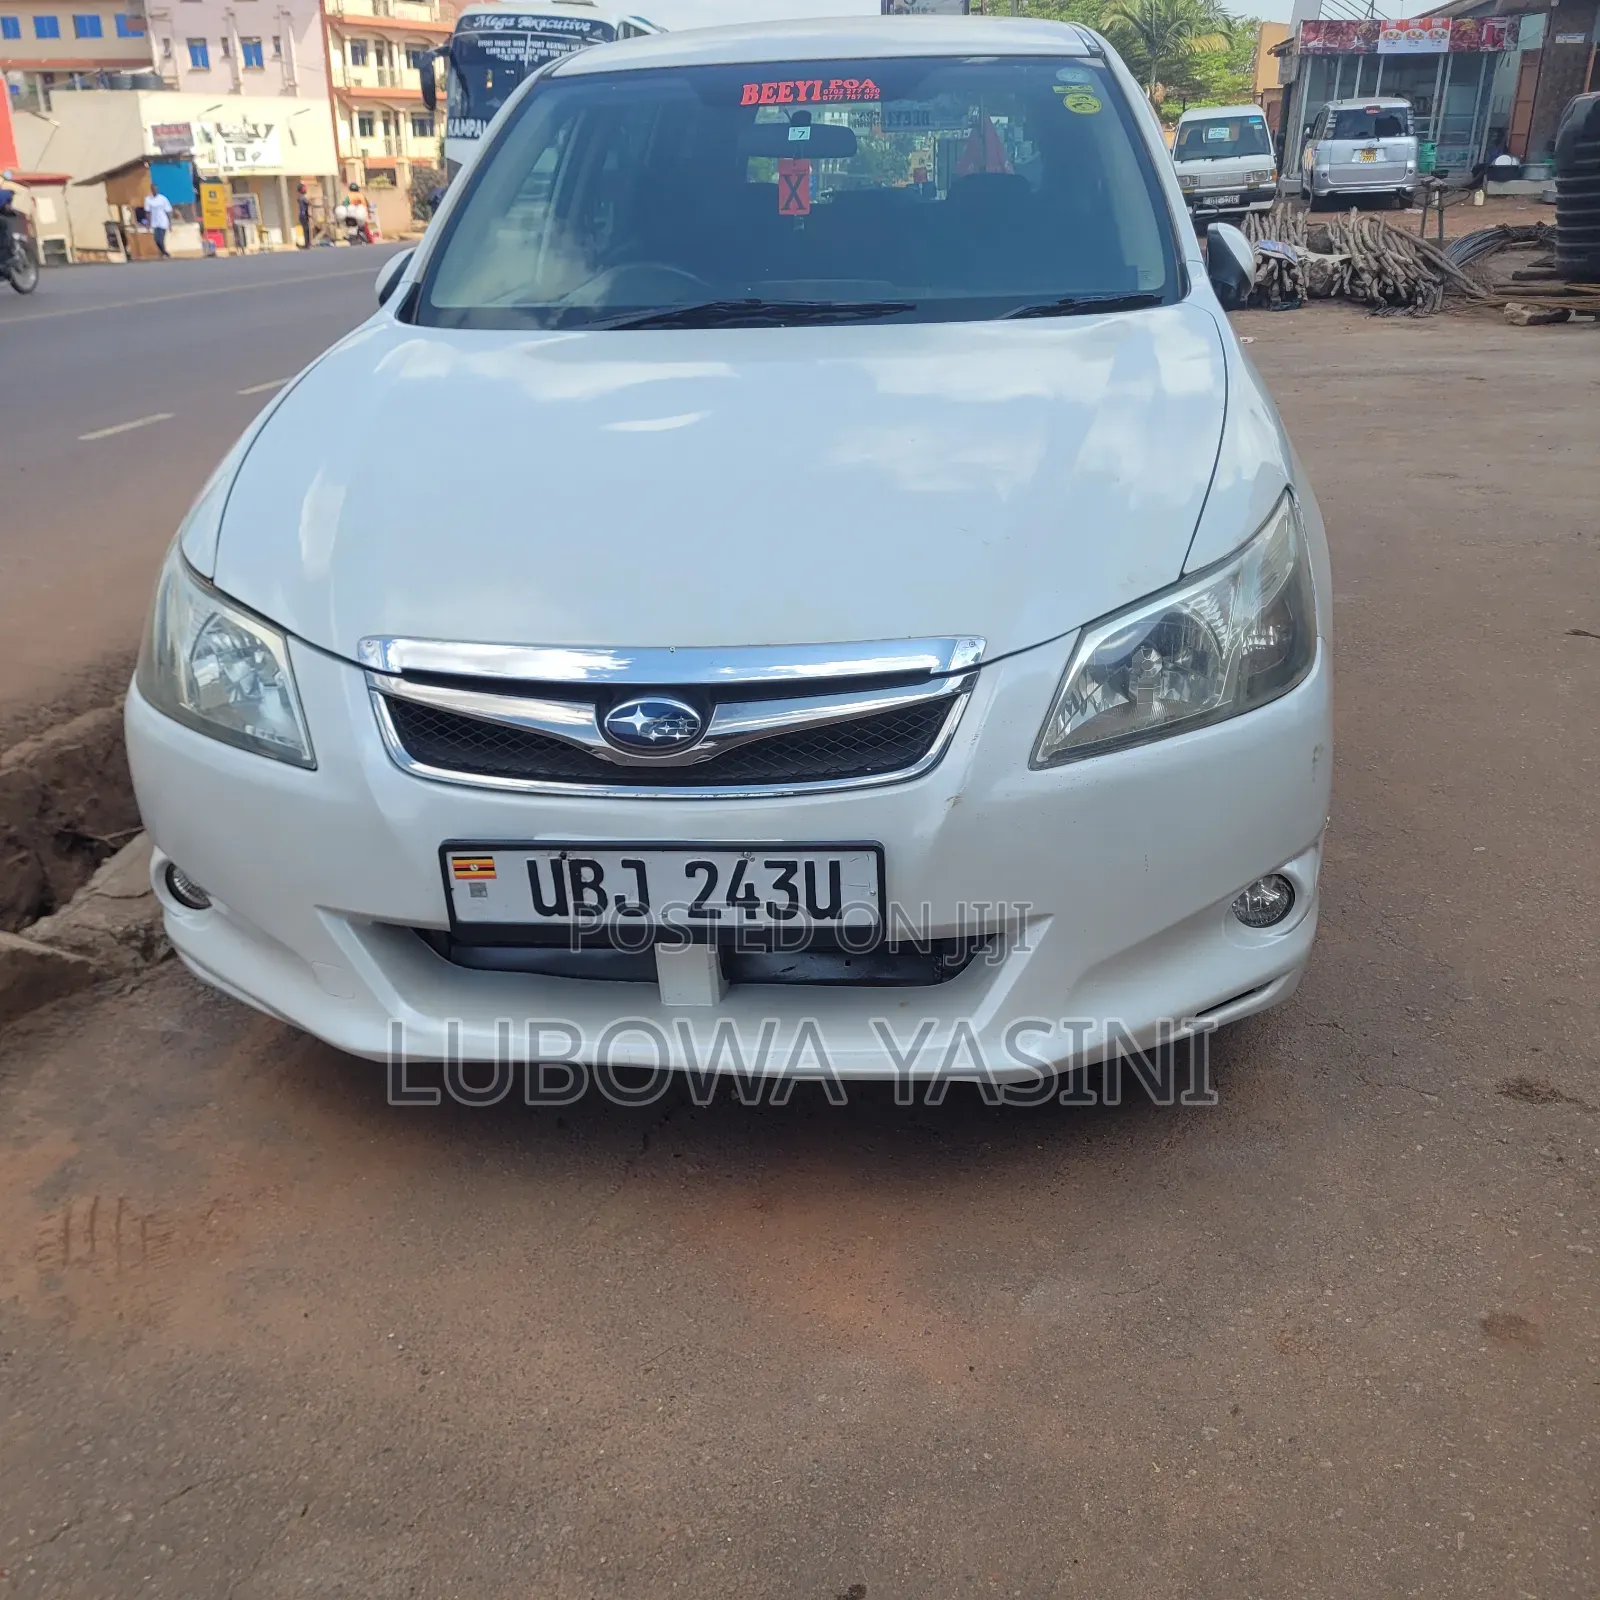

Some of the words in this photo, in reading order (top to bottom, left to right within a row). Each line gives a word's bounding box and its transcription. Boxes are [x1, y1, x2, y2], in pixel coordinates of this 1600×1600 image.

[473, 15, 515, 31] Mega
[740, 80, 823, 105] BEEYI
[829, 79, 876, 89] POA
[526, 858, 650, 917] UBJ
[684, 858, 843, 920] 243U
